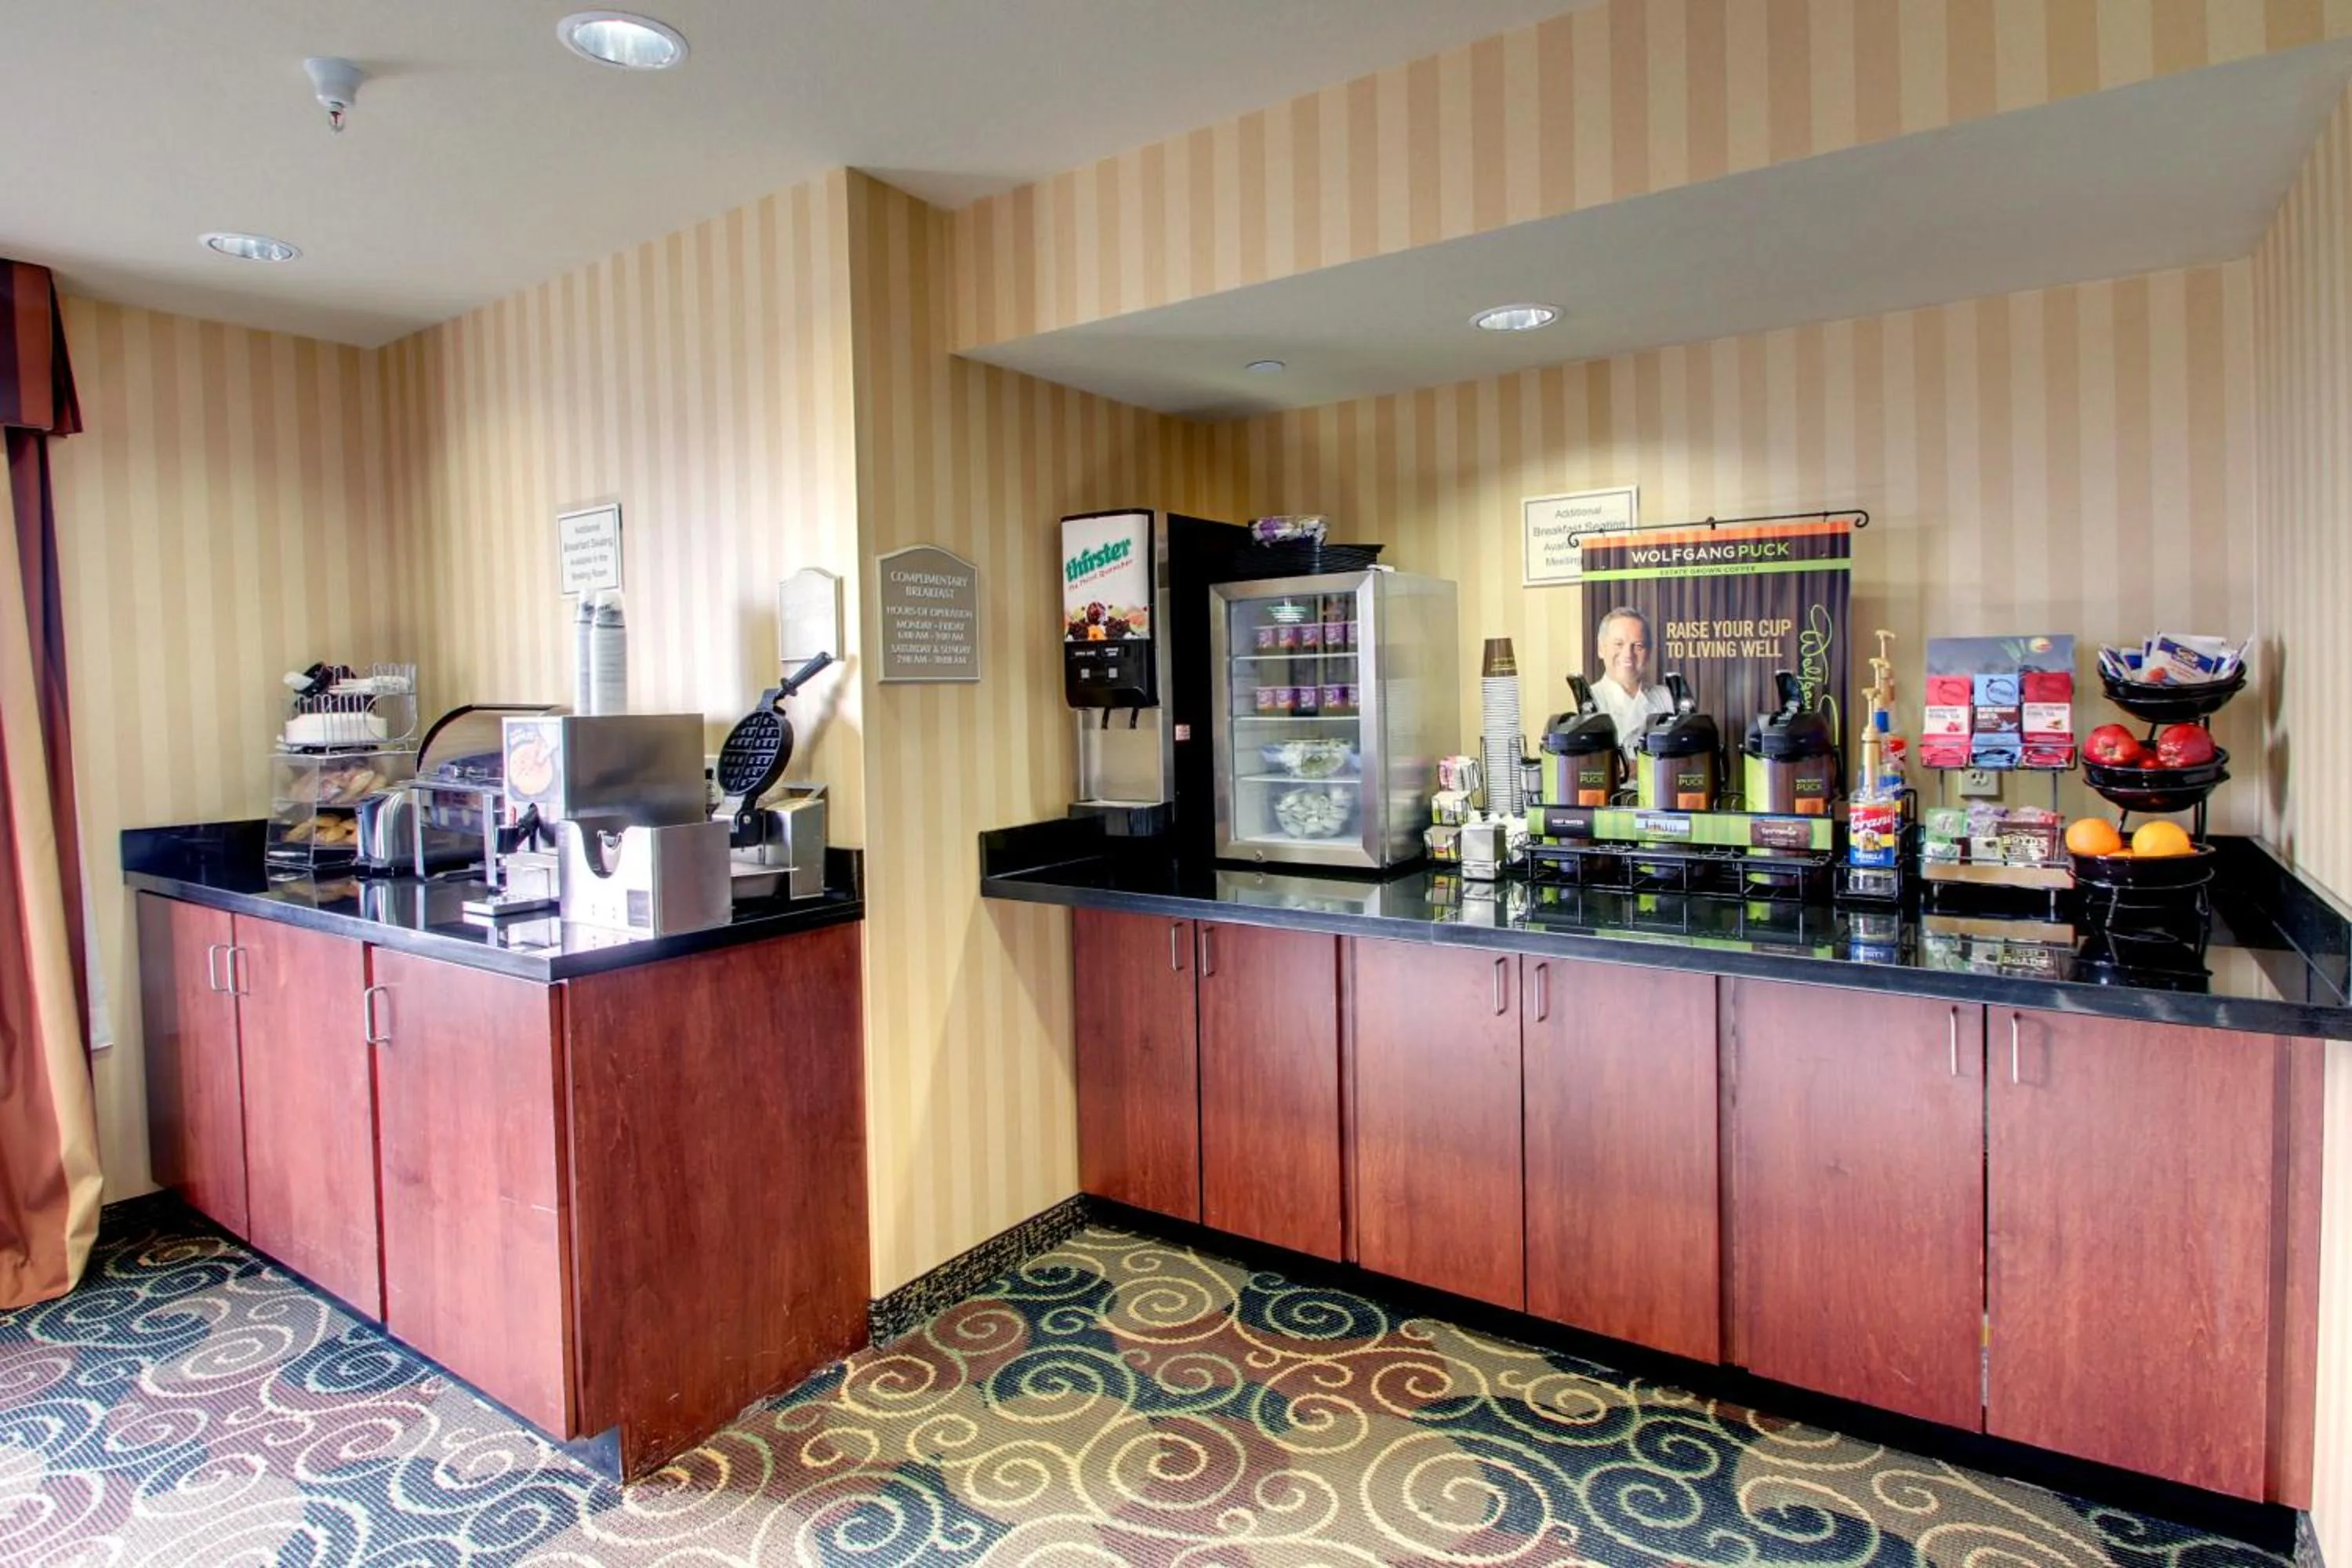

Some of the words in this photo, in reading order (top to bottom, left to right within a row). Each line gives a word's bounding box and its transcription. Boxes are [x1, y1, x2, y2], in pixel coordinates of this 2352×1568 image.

[1065, 538, 1131, 583] thirster
[1666, 622, 1709, 639] RAISE
[1712, 620, 1754, 637] YOUR
[1759, 619, 1791, 637] CUP
[1665, 641, 1684, 659] TO
[1688, 641, 1737, 659] LIVING
[1740, 639, 1784, 659] WELL
